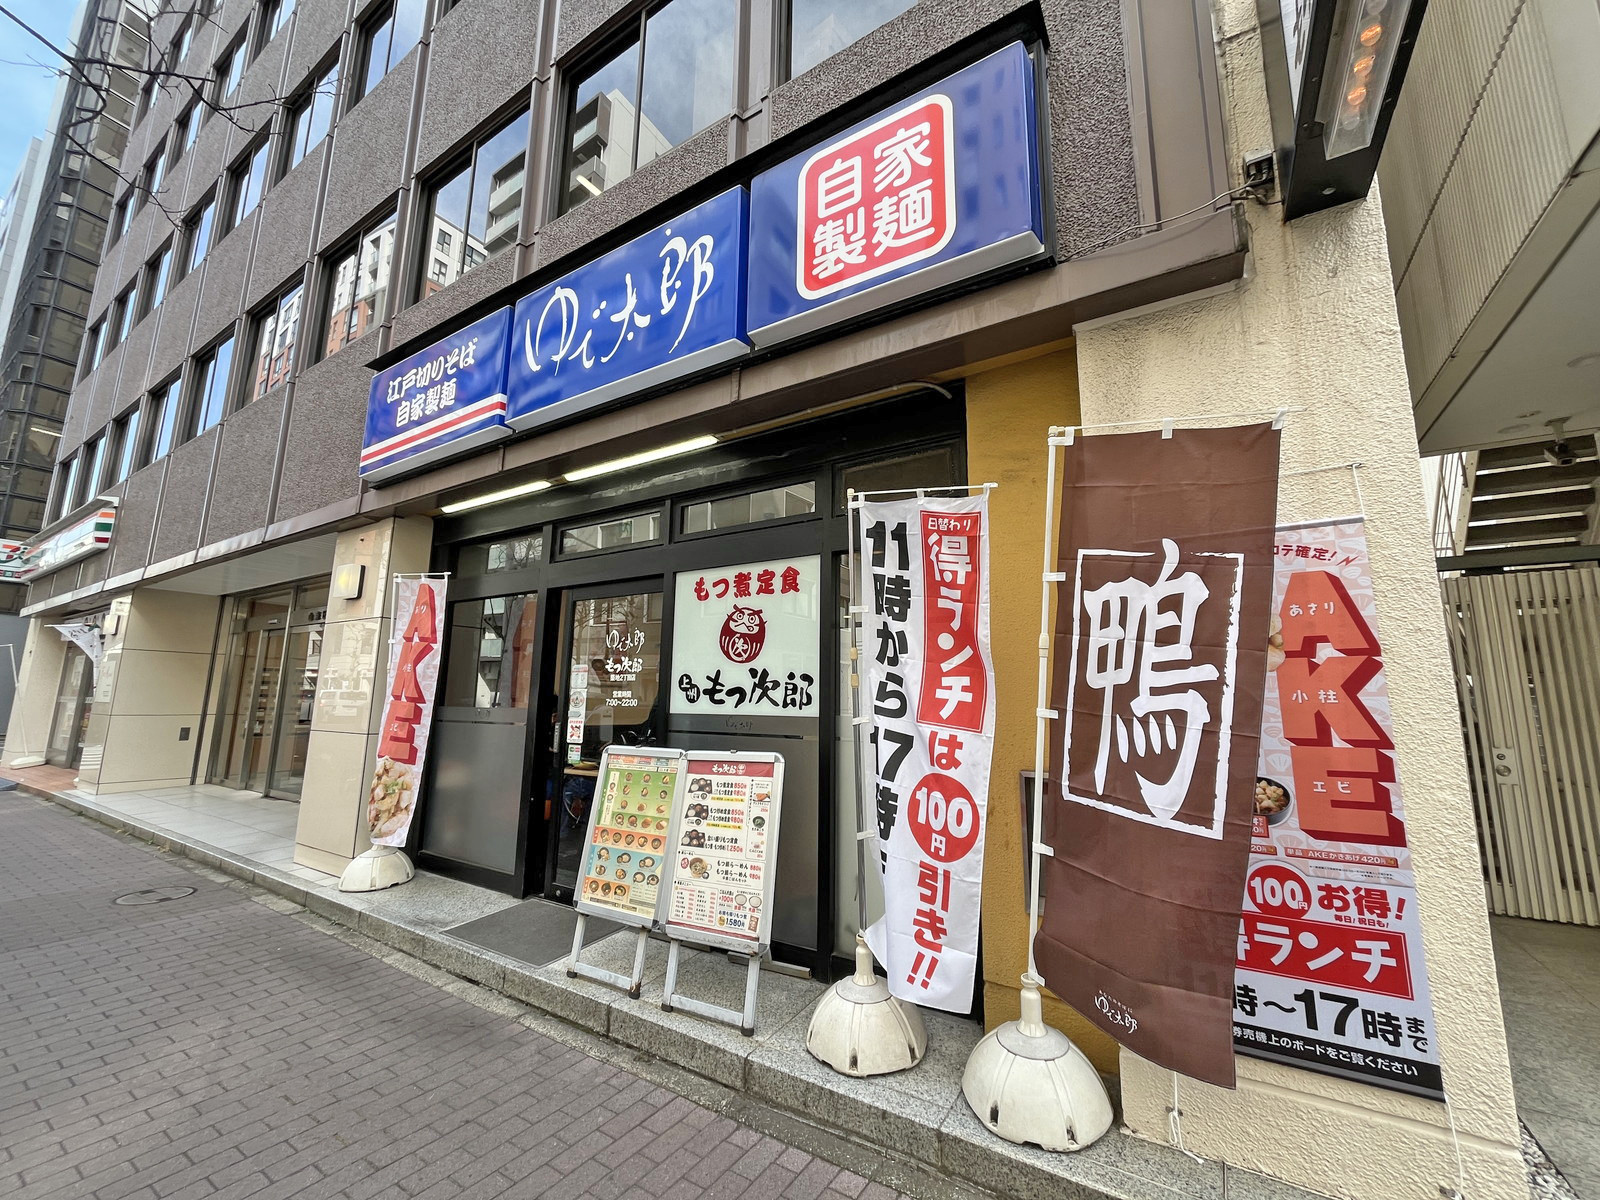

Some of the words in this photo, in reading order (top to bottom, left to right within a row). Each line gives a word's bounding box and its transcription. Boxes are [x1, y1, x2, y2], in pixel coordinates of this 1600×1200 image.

[817, 121, 932, 218] 自家
[812, 178, 935, 280] 製麺
[387, 337, 478, 404] 江戸切りそば
[396, 378, 457, 428] 自家製麺
[927, 516, 972, 532] 日替わり
[693, 565, 801, 602] もつ煮定食
[1289, 601, 1336, 617] あさり
[378, 583, 438, 766] AKE
[605, 655, 643, 674] もつ次郎
[1083, 537, 1220, 821] 鴨
[702, 667, 815, 711] もつ次郎
[1277, 570, 1408, 848] AKE
[1292, 689, 1339, 704] 小柱
[1313, 781, 1351, 794] エビ
[1249, 876, 1308, 911] 100円
[1317, 883, 1406, 921] お得!
